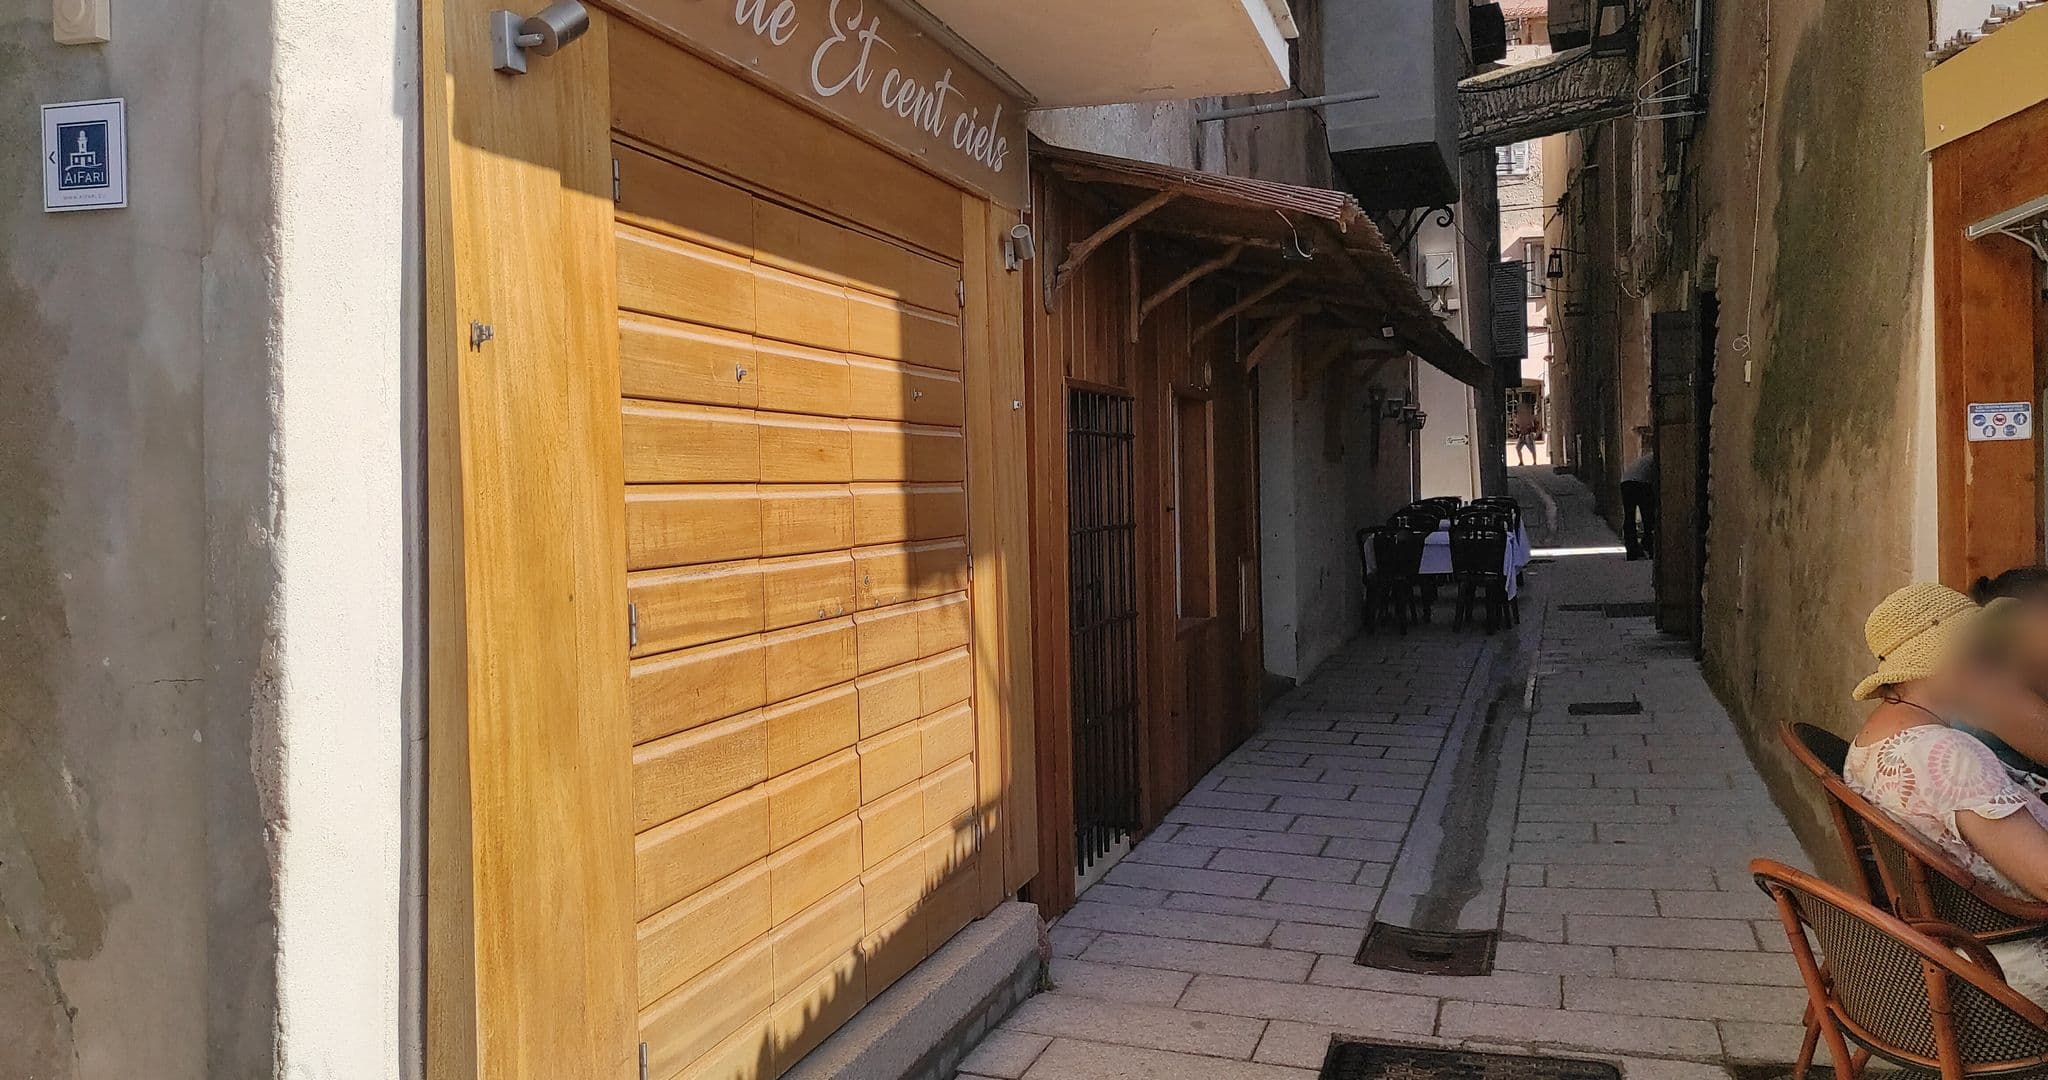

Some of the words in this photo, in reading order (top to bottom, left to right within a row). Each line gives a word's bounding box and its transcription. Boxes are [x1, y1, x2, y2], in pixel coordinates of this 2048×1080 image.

[811, 0, 897, 97] Et
[881, 68, 966, 138] cent
[952, 103, 1010, 173] ciels
